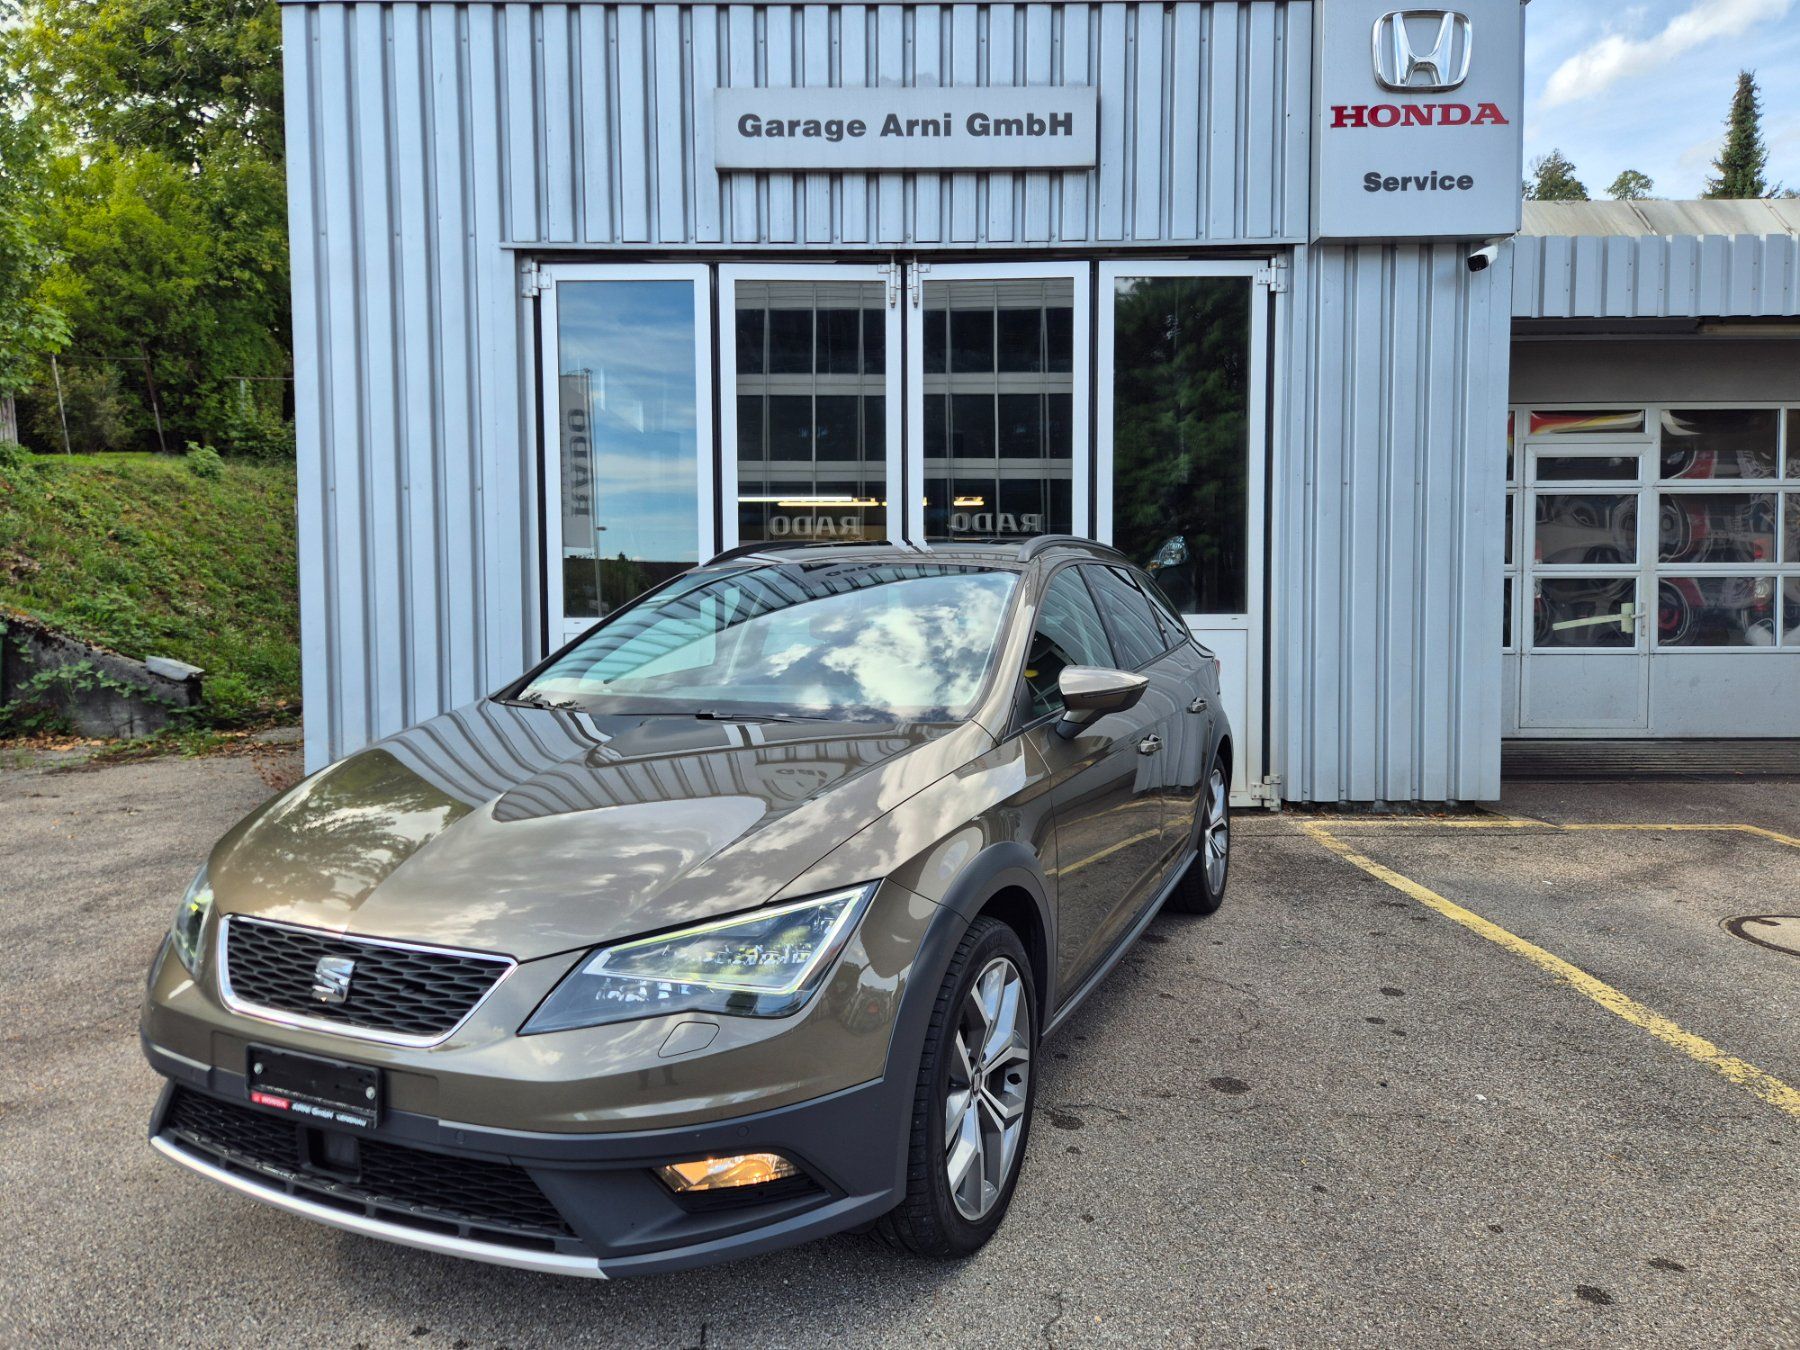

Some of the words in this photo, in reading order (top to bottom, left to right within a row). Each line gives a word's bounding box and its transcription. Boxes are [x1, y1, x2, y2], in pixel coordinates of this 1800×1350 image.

[737, 113, 867, 142] Garage
[879, 112, 952, 137] Arni
[965, 112, 1073, 137] GmbH
[1330, 103, 1510, 128] HONDA
[1363, 171, 1474, 192] Service
